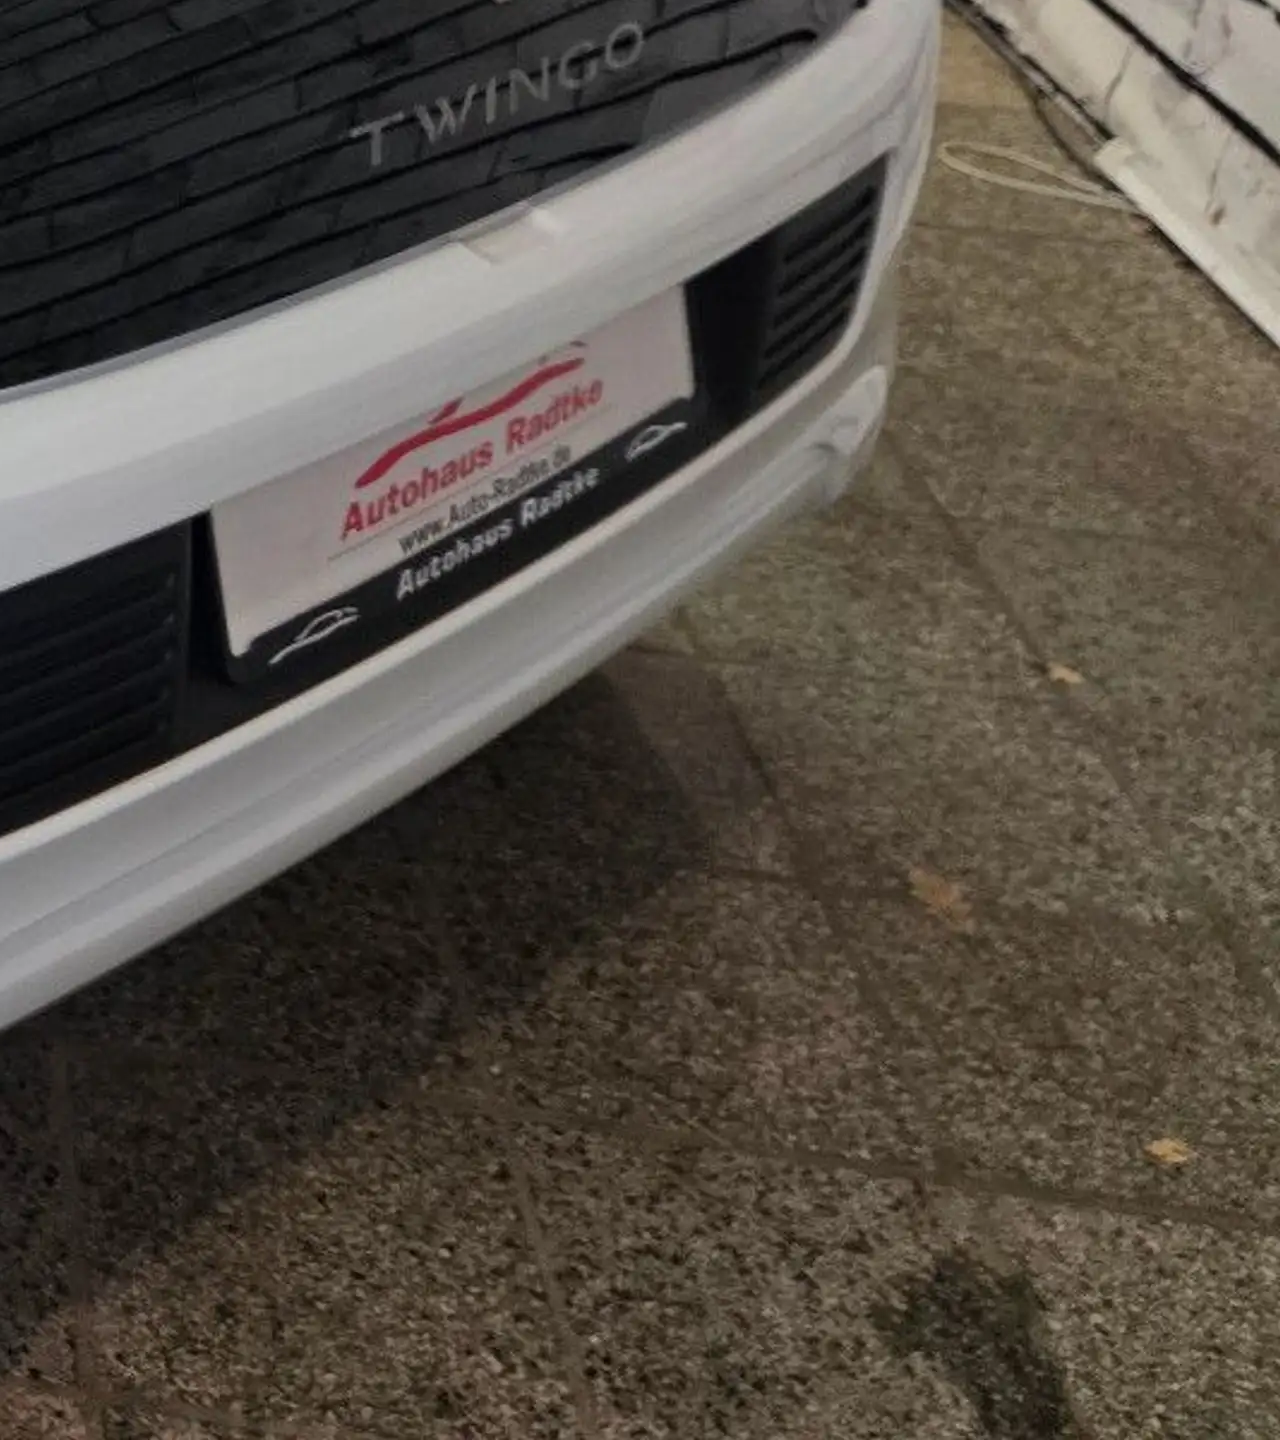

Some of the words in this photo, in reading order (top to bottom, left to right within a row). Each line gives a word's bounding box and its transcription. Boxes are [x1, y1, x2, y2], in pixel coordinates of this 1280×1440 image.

[348, 20, 644, 168] TWINGO
[339, 440, 494, 541] Autohaus
[505, 379, 603, 454] Radtke
[395, 517, 514, 602] Autohaus
[521, 467, 601, 530] Radtke
